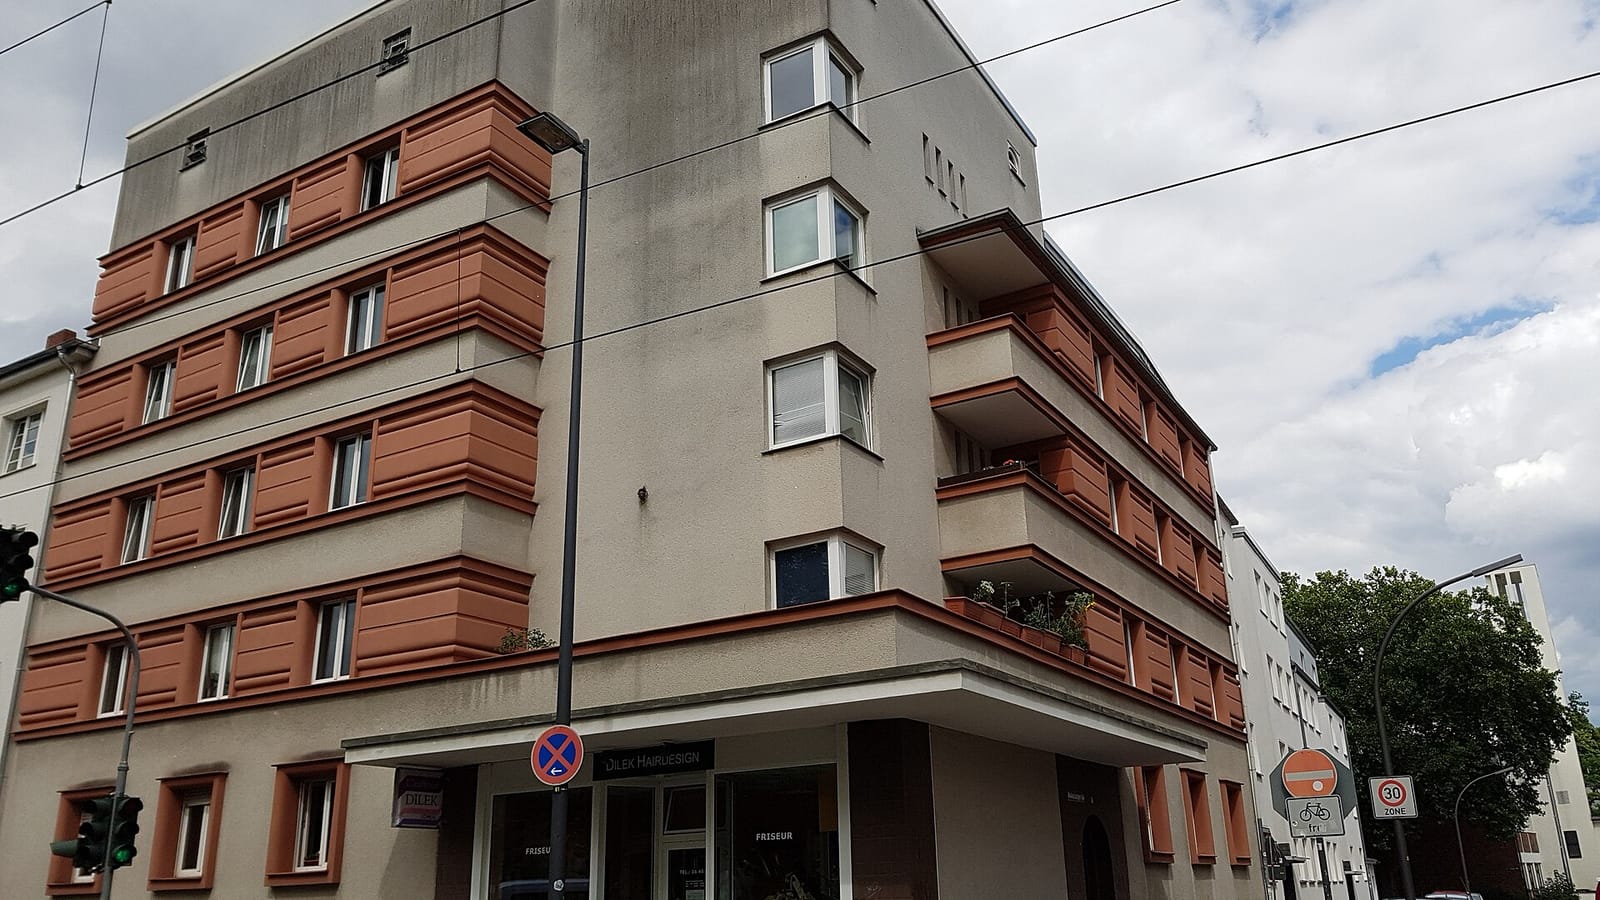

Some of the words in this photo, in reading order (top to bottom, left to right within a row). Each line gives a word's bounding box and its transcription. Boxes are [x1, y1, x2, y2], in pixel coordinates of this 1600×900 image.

[606, 758, 635, 771] DILEK
[637, 751, 700, 769] HAIRDESIGN
[405, 790, 438, 807] DILEK
[1384, 787, 1401, 800] 30
[1384, 807, 1407, 816] ZONE
[756, 831, 793, 841] FRISEUR
